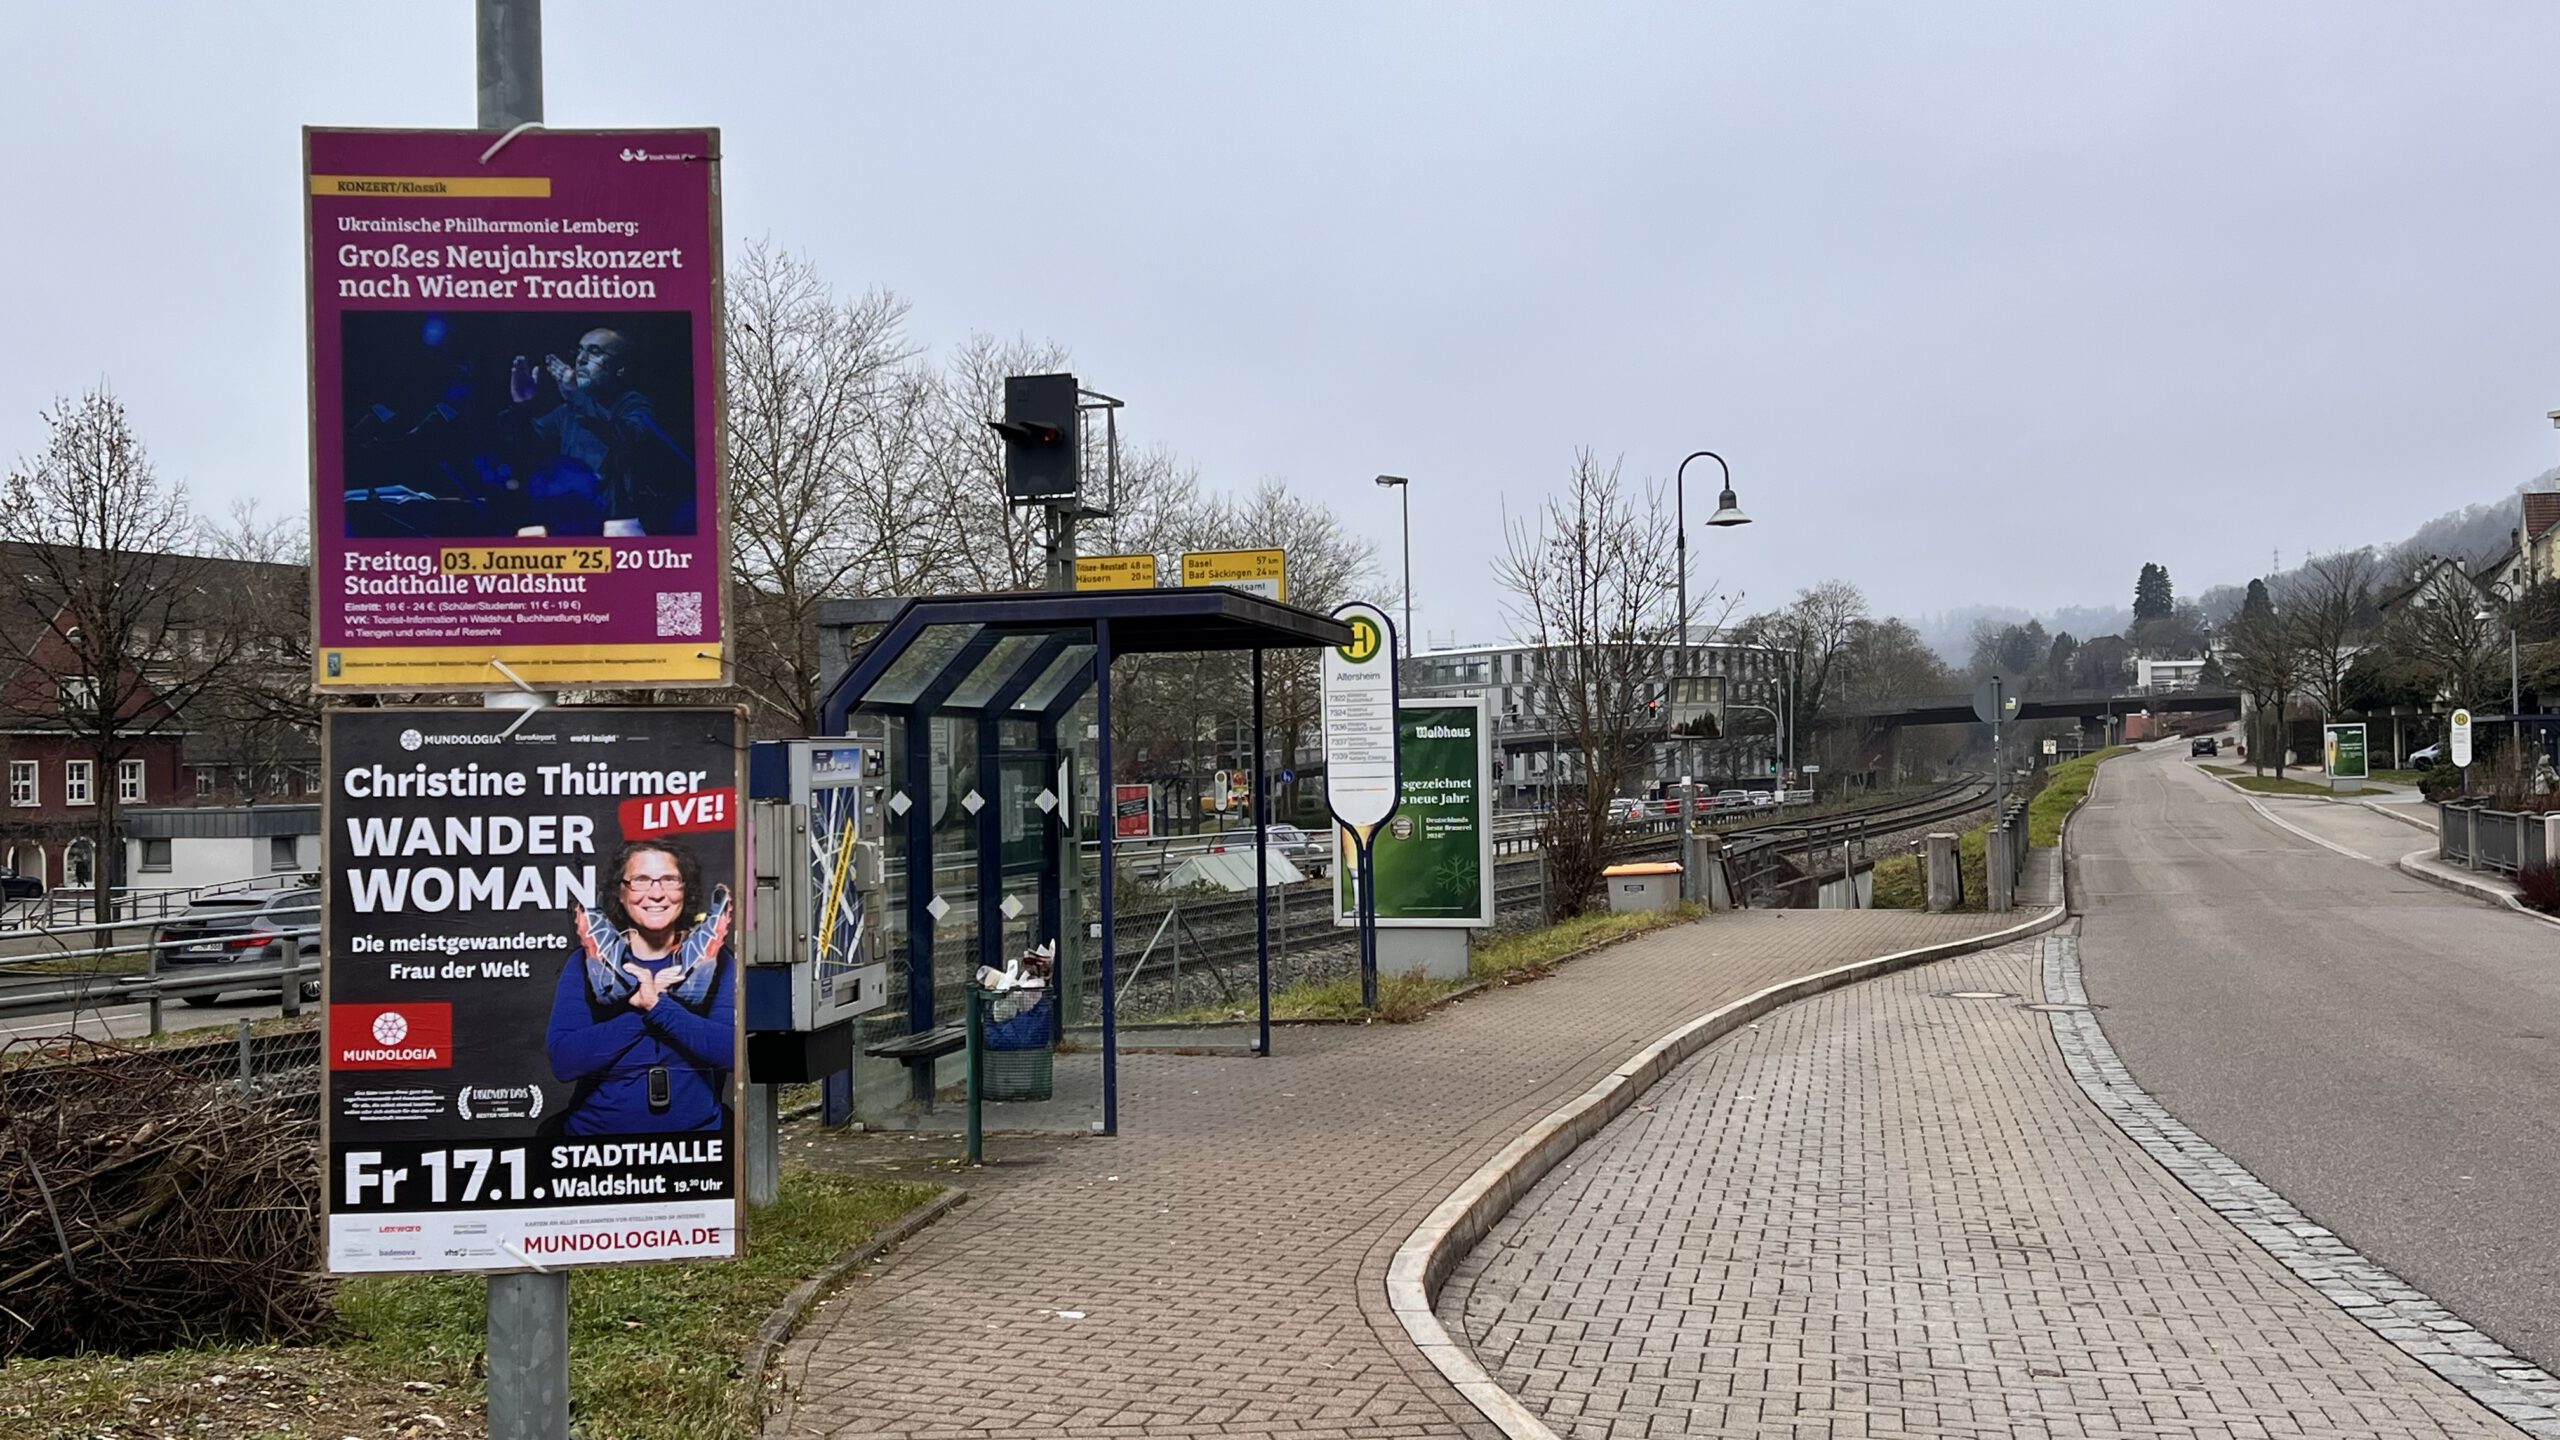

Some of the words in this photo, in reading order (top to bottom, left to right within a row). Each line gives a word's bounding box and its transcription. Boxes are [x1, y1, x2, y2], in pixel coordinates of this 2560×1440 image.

[337, 181, 447, 194] KONZERT/Klassik
[337, 217, 441, 233] Ukrainische
[444, 217, 559, 234] Philharmonie
[562, 218, 639, 237] Lemberg:
[338, 243, 439, 268] Großes
[446, 244, 683, 274] Neujahrskonzert
[338, 274, 411, 298] nach
[418, 274, 517, 299] Wiener
[524, 274, 656, 299] Tradition
[344, 551, 438, 575] Freitag,
[443, 552, 477, 570] 03.
[483, 551, 566, 570] Januar
[616, 550, 645, 569] 20
[647, 549, 693, 569] Uhr
[1188, 559, 1212, 568] Basel
[1256, 556, 1266, 564] 57
[1131, 573, 1140, 581] 20
[1189, 570, 1205, 579] Bad
[1208, 569, 1252, 579] Säckingen
[1256, 568, 1267, 576] 24
[344, 575, 469, 595] Stadthalle
[473, 574, 586, 594] Waldshut
[344, 602, 382, 612] Eintritt:
[398, 602, 405, 611] €
[412, 602, 425, 611] 24
[530, 601, 540, 610] 11
[542, 601, 549, 610] €
[558, 601, 569, 610] 19
[570, 600, 581, 611] €)
[344, 616, 370, 624] VVK:
[372, 615, 458, 624] Tourist-Information
[459, 615, 468, 623] in
[470, 615, 514, 624] Waldshut,
[517, 614, 581, 624] Buchhandlung
[583, 613, 610, 624] Kögel
[345, 629, 354, 637] in
[395, 628, 413, 637] und
[415, 628, 443, 637] online
[445, 628, 460, 637] auf
[462, 627, 501, 637] Reservix
[1349, 626, 1367, 653] H
[424, 734, 501, 745] MUNDOLOGIA
[570, 734, 590, 743] world
[1416, 726, 1471, 739] Waldhaus
[344, 763, 527, 798] Christine
[537, 762, 707, 795] Thürmer
[1402, 778, 1472, 792] sgezeichnet
[1410, 795, 1438, 804] neue
[1439, 793, 1470, 806] Jahr:
[642, 794, 725, 832] LIVE!
[346, 815, 596, 857] WANDER
[346, 865, 597, 913] WOMAN
[351, 936, 385, 954] Die
[389, 933, 568, 956] meistgewanderte
[389, 963, 436, 981] Frau
[439, 961, 477, 979] der
[481, 961, 530, 979] Welt
[343, 1048, 437, 1062] MUNDOLOGIA
[551, 1140, 723, 1169] STADTHALLE
[345, 1151, 408, 1204] Fr
[420, 1148, 545, 1203] 17.1.
[552, 1174, 666, 1199] Waldshut
[700, 1178, 723, 1192] Uhr
[524, 1227, 721, 1254] MUNDOLOGIA.DE
